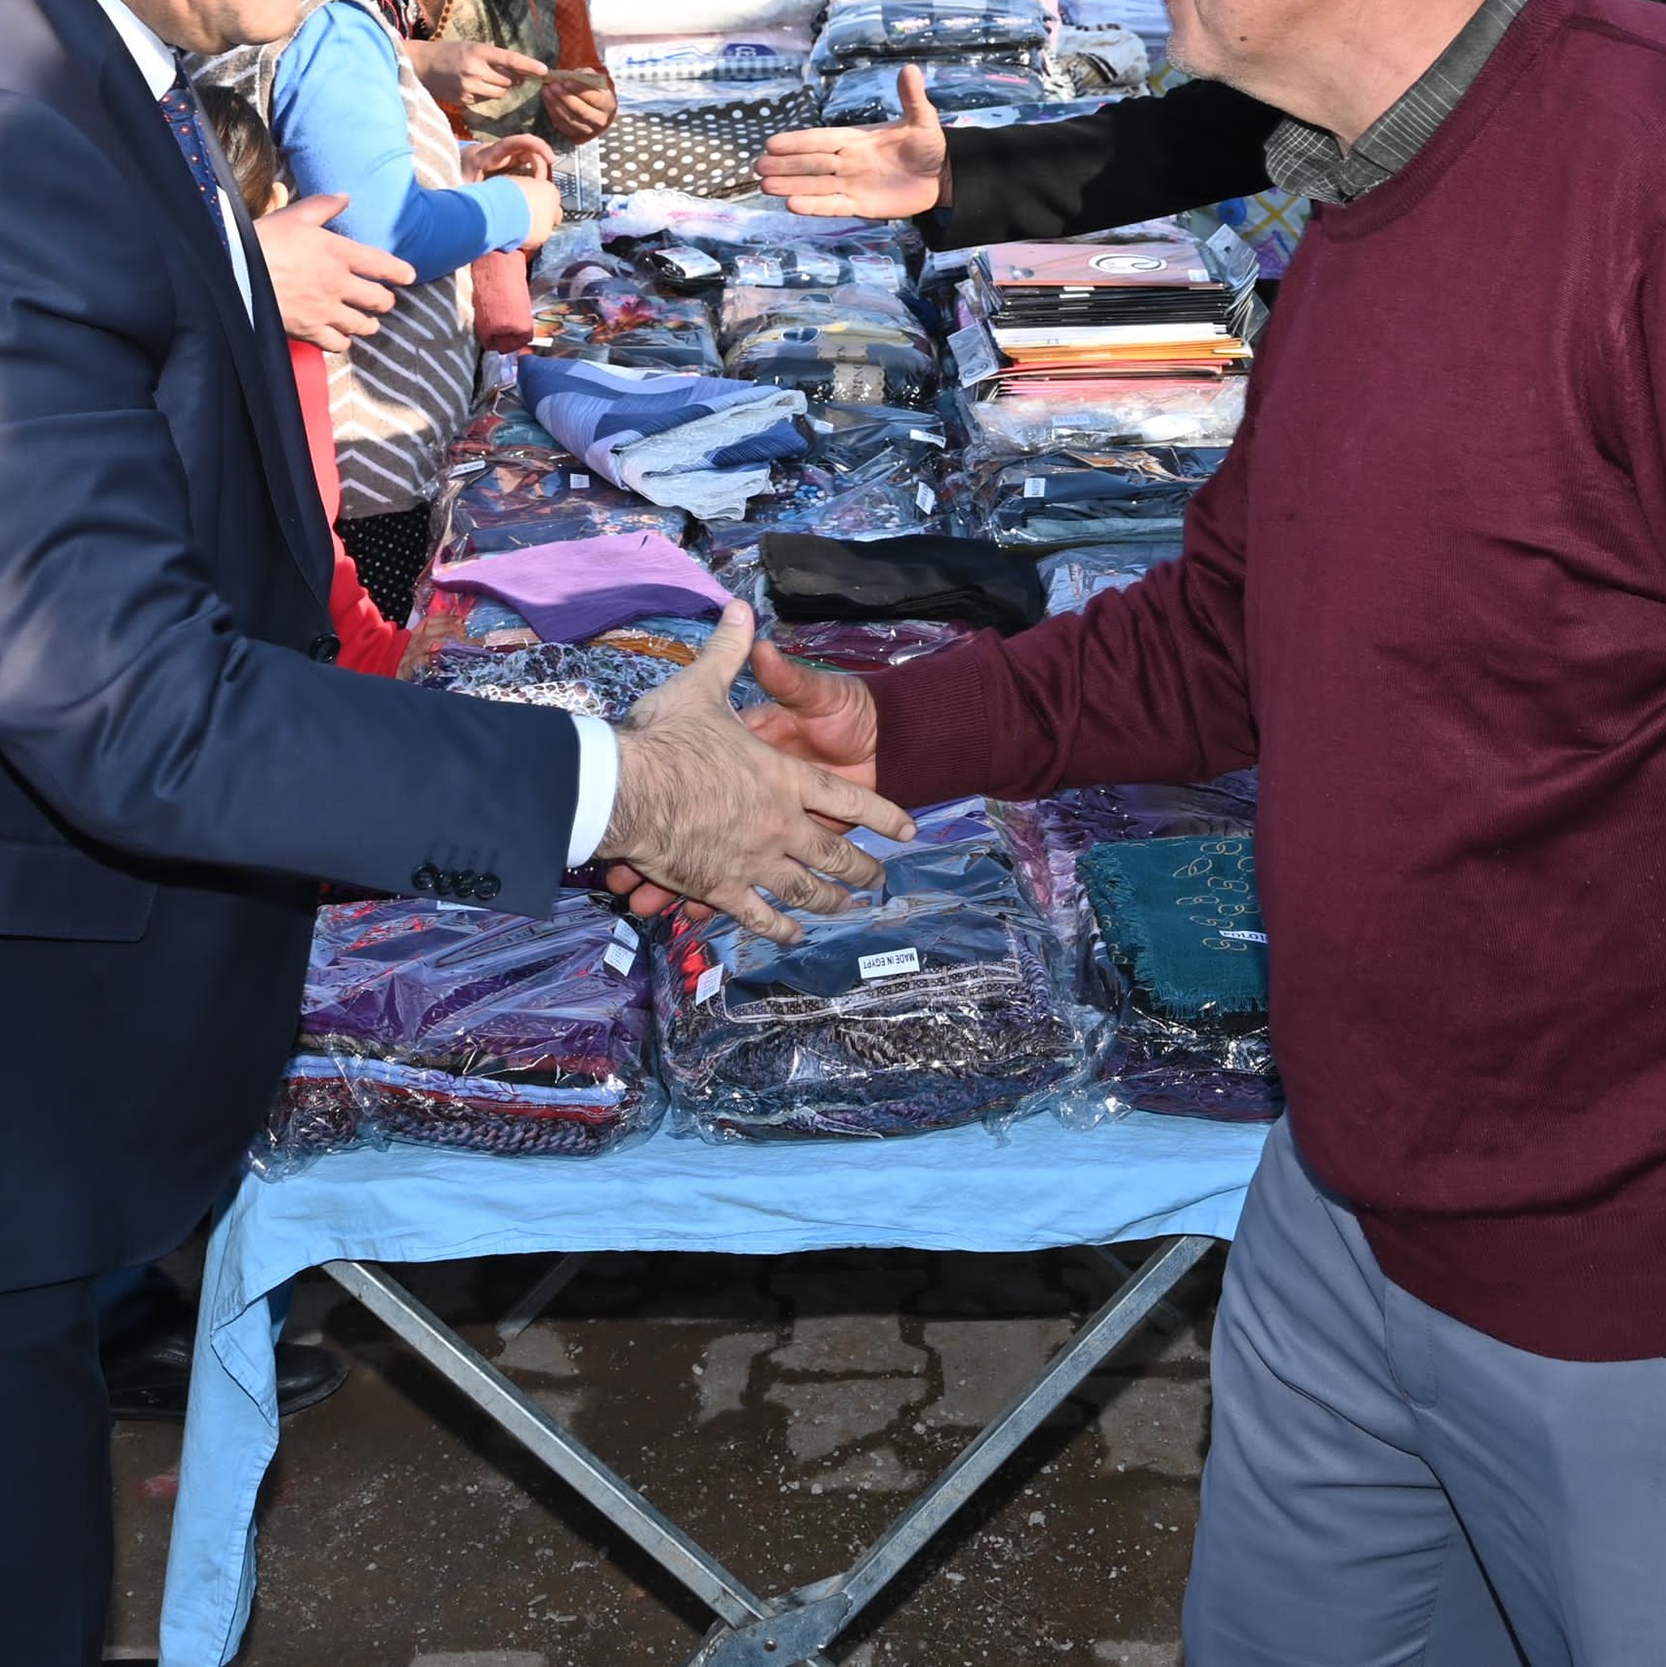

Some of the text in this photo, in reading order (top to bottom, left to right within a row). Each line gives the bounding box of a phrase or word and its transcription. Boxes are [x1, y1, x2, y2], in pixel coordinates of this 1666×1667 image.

[863, 952, 915, 969] MADE IN EGYPT
